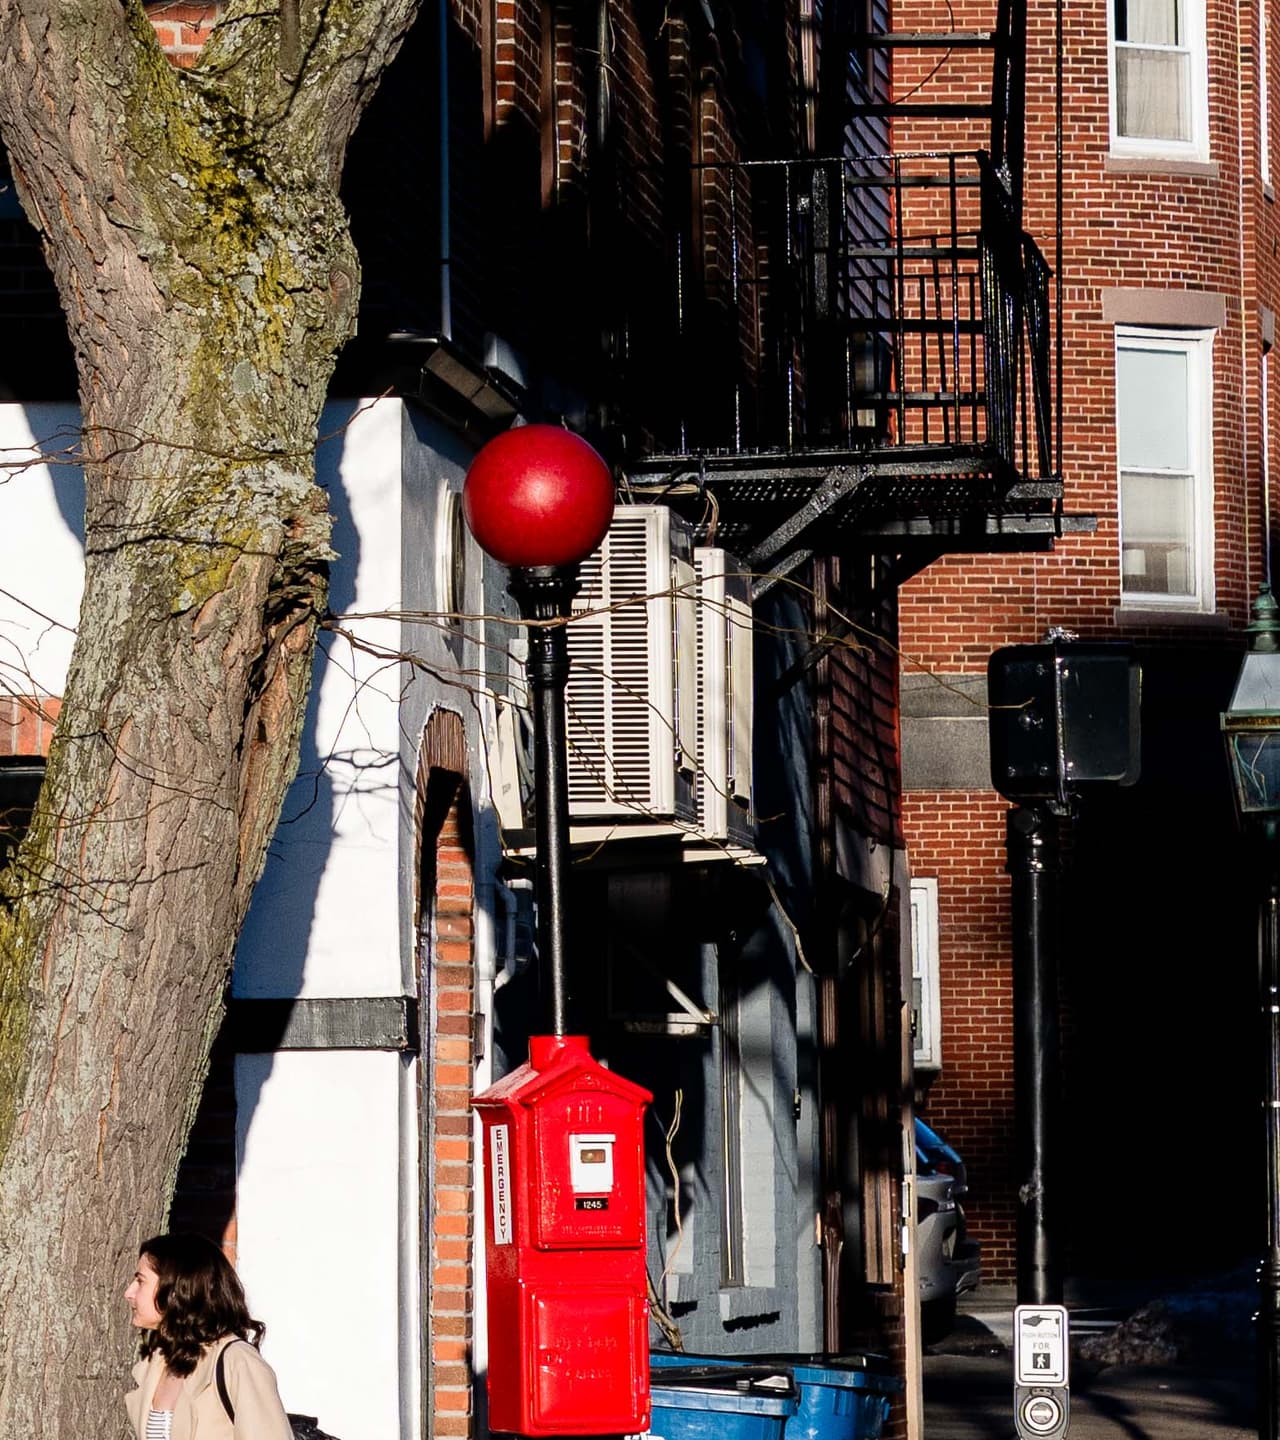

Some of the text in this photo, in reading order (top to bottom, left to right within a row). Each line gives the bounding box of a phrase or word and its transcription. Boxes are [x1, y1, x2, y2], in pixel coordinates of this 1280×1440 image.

[495, 1129, 507, 1239] EMERGENCY
[583, 1201, 603, 1209] 1245
[1032, 1342, 1051, 1350] FOR
